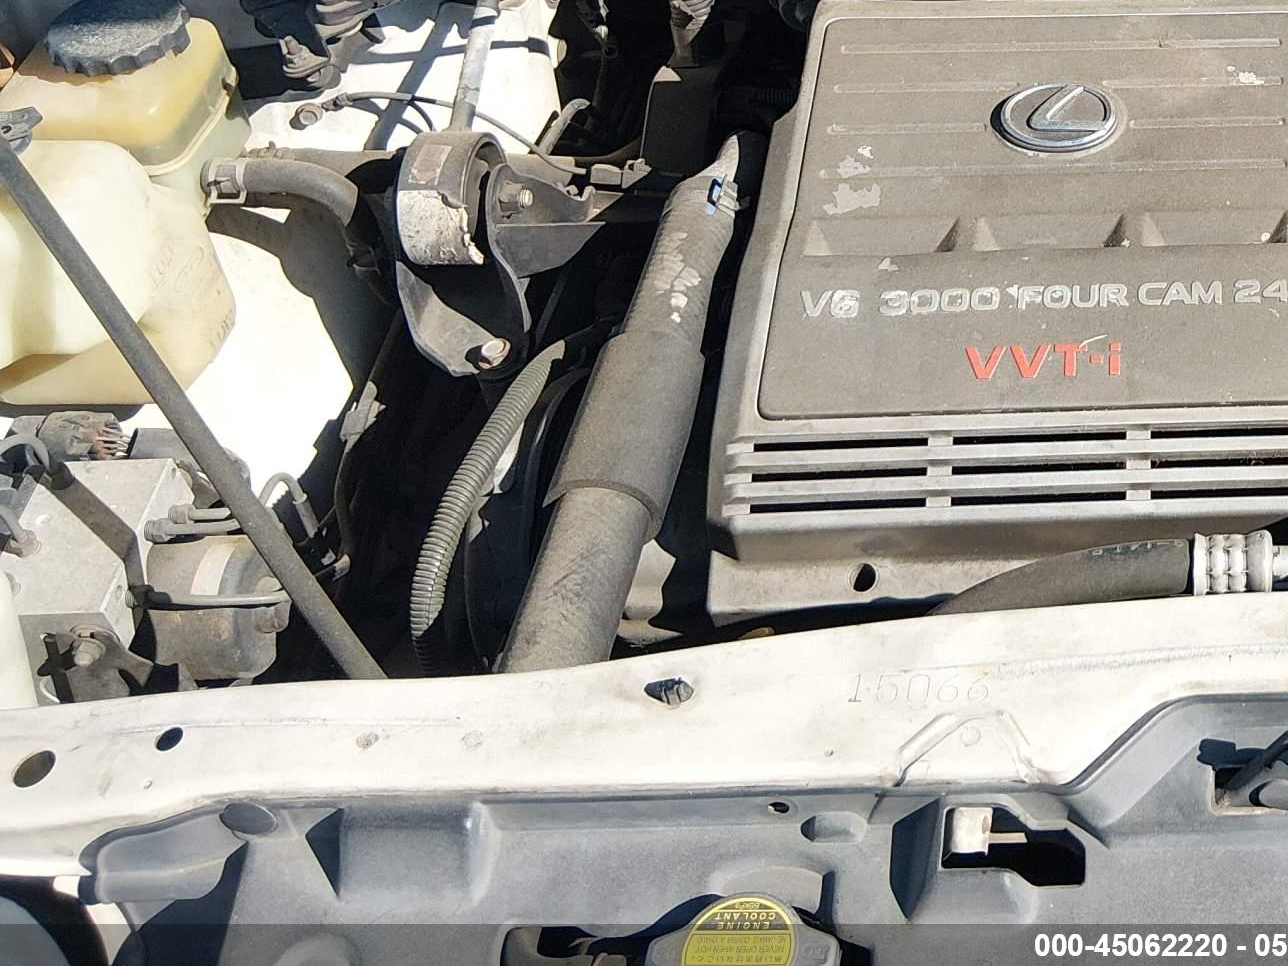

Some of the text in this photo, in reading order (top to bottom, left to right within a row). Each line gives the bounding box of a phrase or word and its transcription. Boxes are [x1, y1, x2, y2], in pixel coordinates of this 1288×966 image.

[800, 289, 861, 318] V6
[878, 286, 1001, 316] 3000
[1015, 283, 1130, 311] FOUR
[1137, 280, 1224, 307] CAM
[965, 341, 1122, 379] VVT-i
[714, 912, 776, 920] COOLANT
[716, 921, 771, 930] ENGINE
[711, 945, 735, 954] WHEN
[735, 945, 758, 954] OPEN
[759, 945, 785, 954] NEVER
